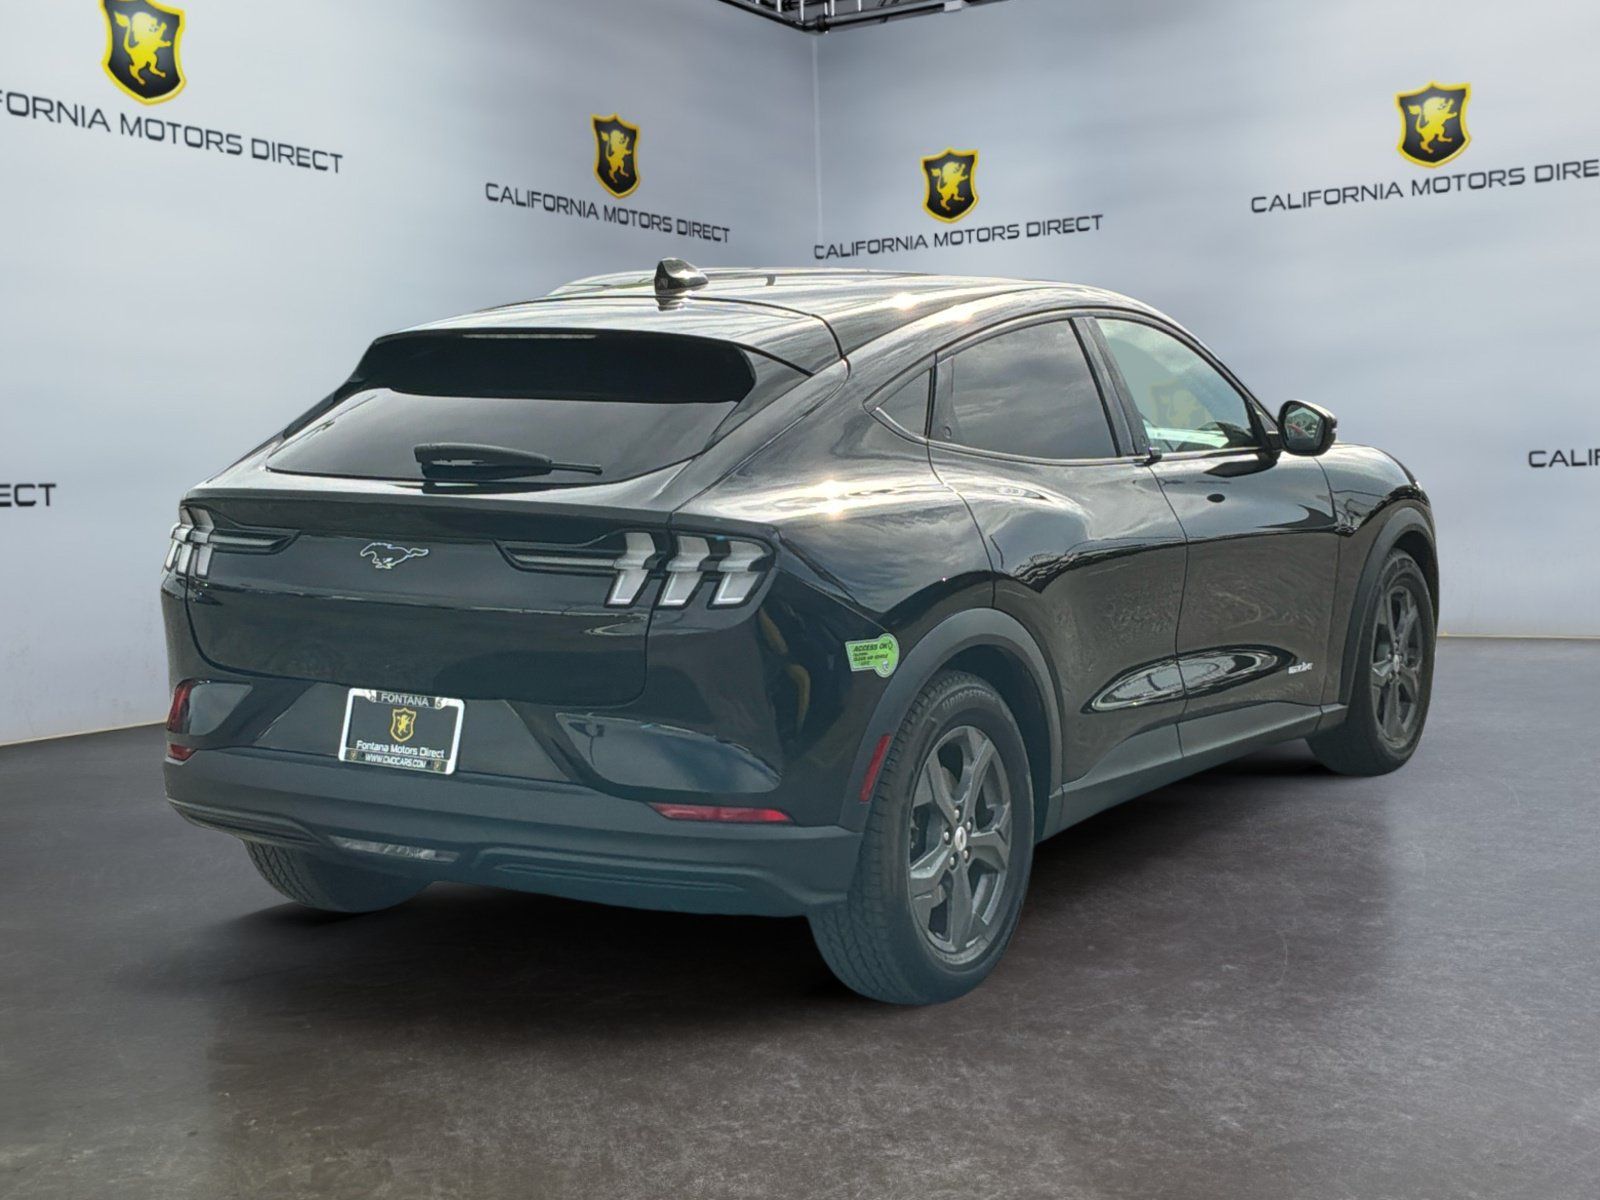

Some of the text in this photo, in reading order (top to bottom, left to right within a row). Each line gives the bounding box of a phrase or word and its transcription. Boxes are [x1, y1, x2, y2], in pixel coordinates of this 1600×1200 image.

[0, 89, 344, 174] ORNIA MOTORS DIRECT
[1250, 158, 1600, 214] CALIFORNIA MOTORS DIRE
[485, 182, 731, 243] CALIFORNIA MOTORS DIRECT
[813, 213, 1104, 260] CALIFORNIA MOTORS DIRECT
[381, 692, 430, 707] FONTANA
[356, 740, 445, 759] Fontana Motors Direct
